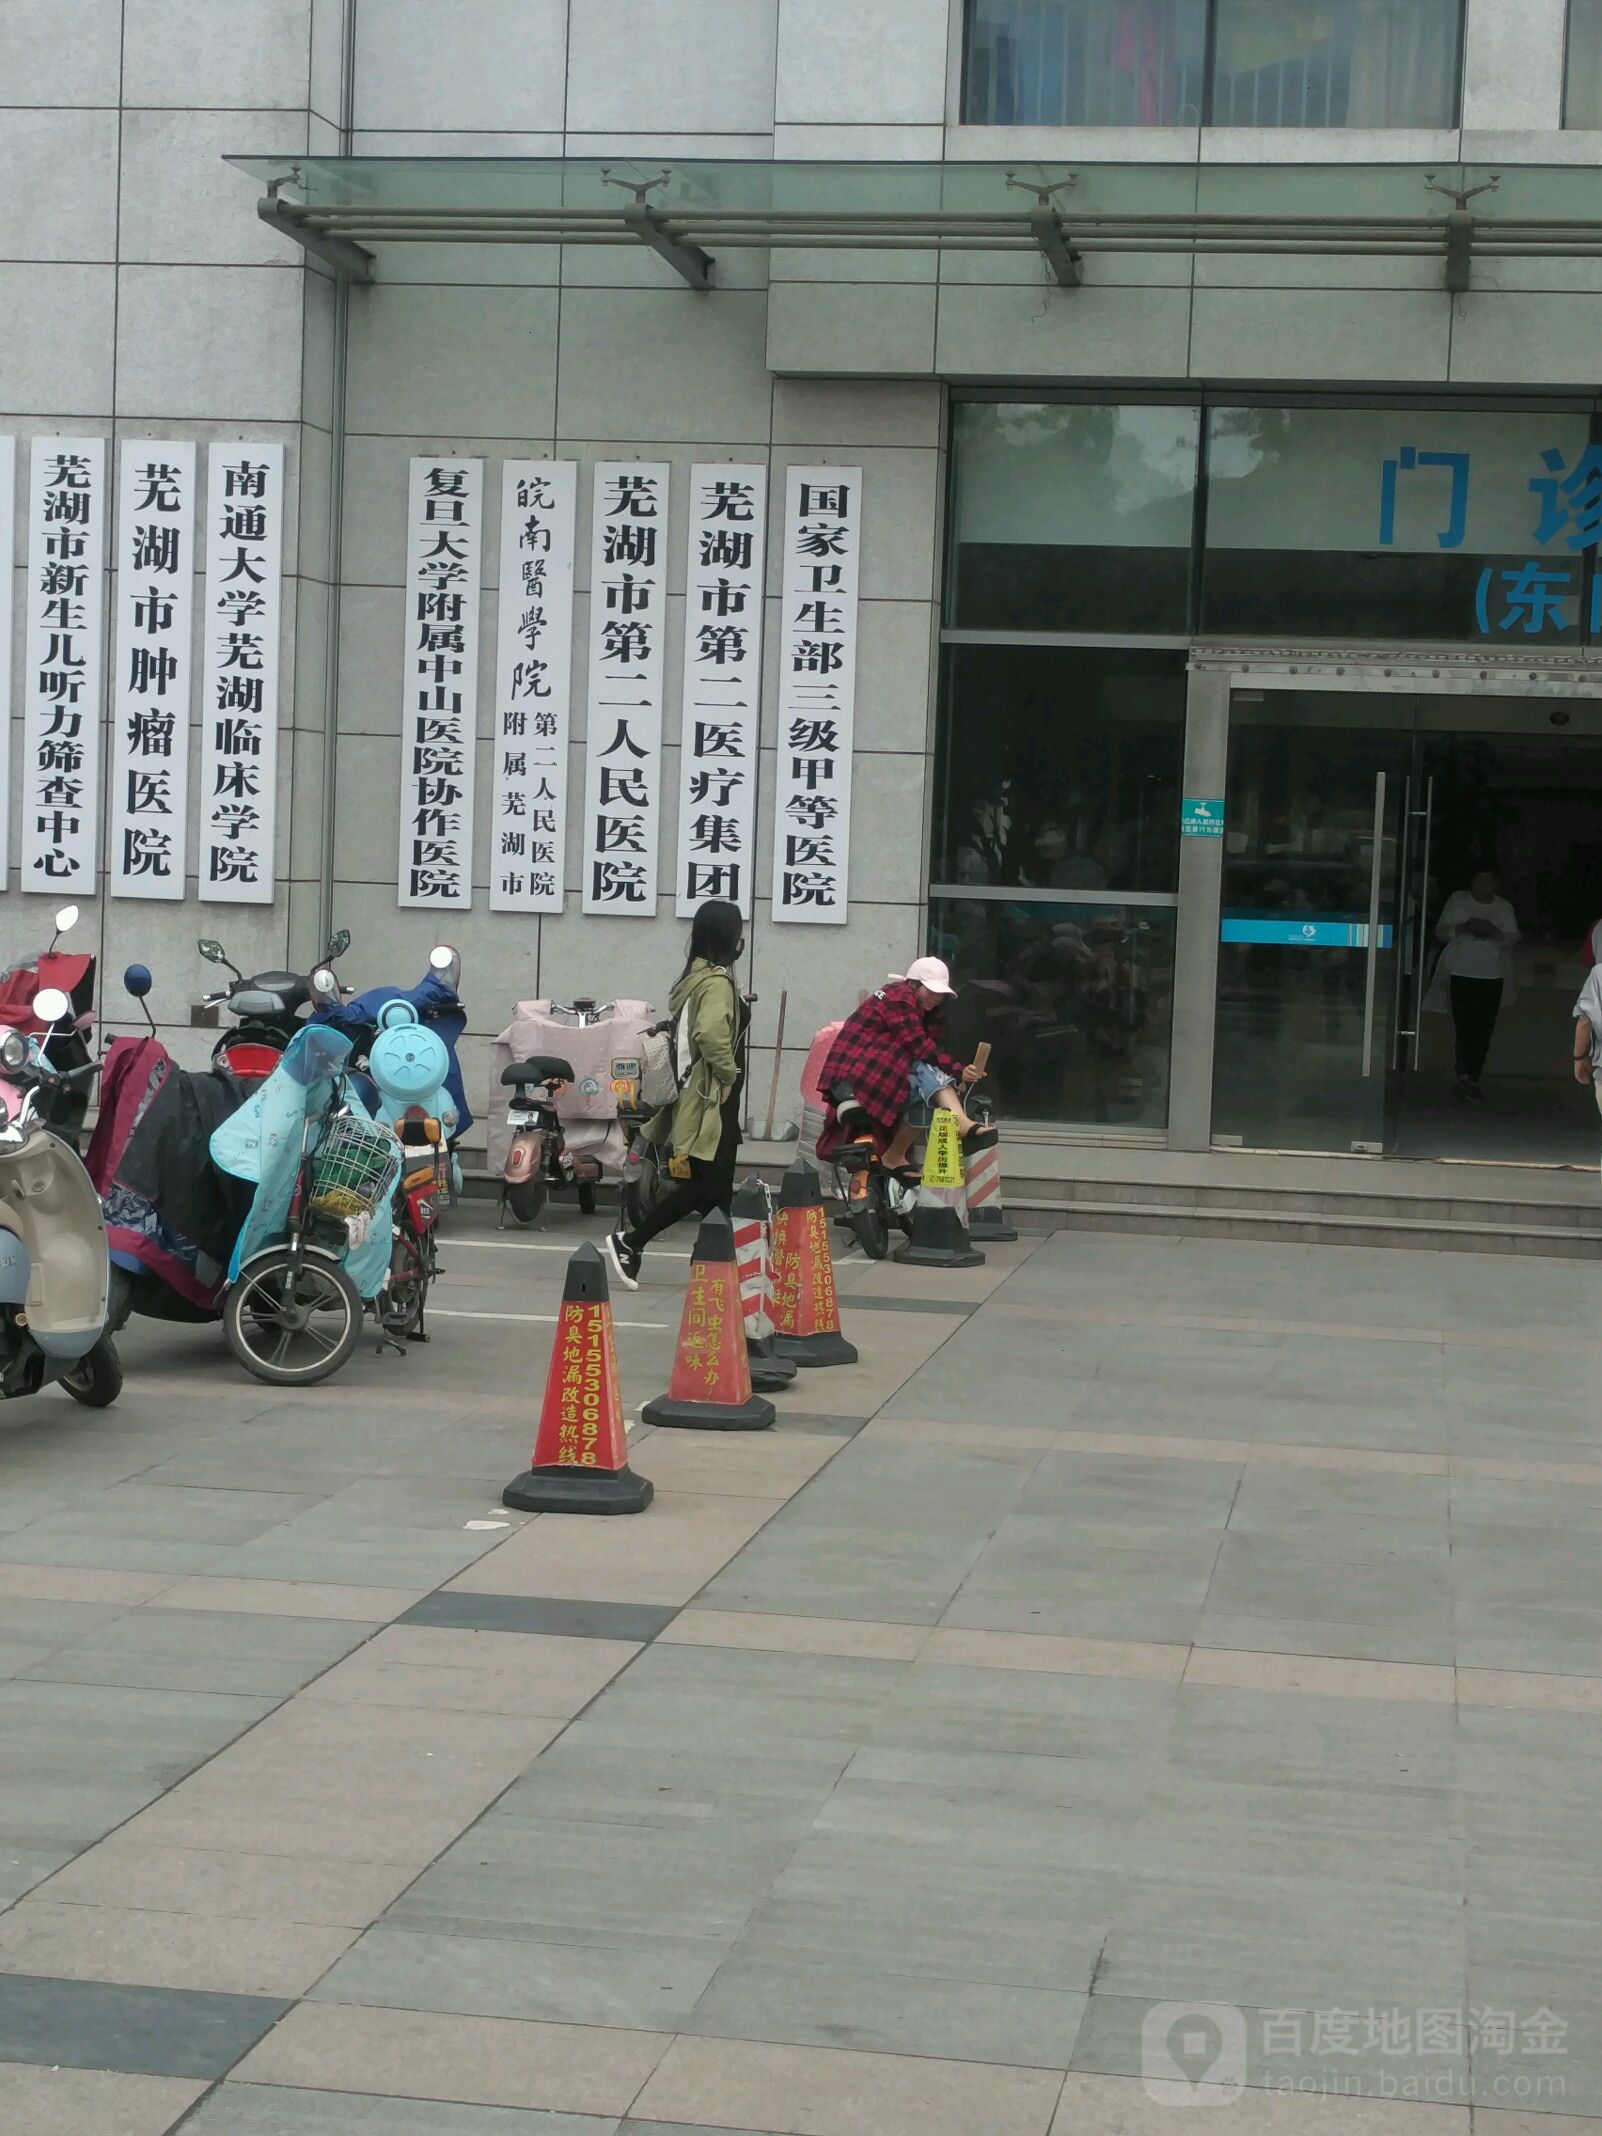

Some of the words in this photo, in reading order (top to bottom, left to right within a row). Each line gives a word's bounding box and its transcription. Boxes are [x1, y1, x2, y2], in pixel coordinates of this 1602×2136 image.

[33, 454, 92, 878] 芜湖市新生儿听力筛查中心
[122, 462, 183, 877] 芜湖市肿瘤医院
[208, 460, 271, 884] 南通大学芜湖临床学院
[409, 466, 470, 899] 复旦大学附属中山医院协作医院
[500, 711, 526, 896] 附属芜湖市
[529, 711, 558, 897] 第二人民医院
[591, 475, 659, 903] 芜湖市第二人民医院
[686, 481, 755, 902] 芜湖市第二医疗集团
[781, 482, 851, 907] 国家卫生部三级甲等医院
[558, 1305, 585, 1464] 防臭地漏改造热线
[580, 1304, 603, 1465] 15155306878
